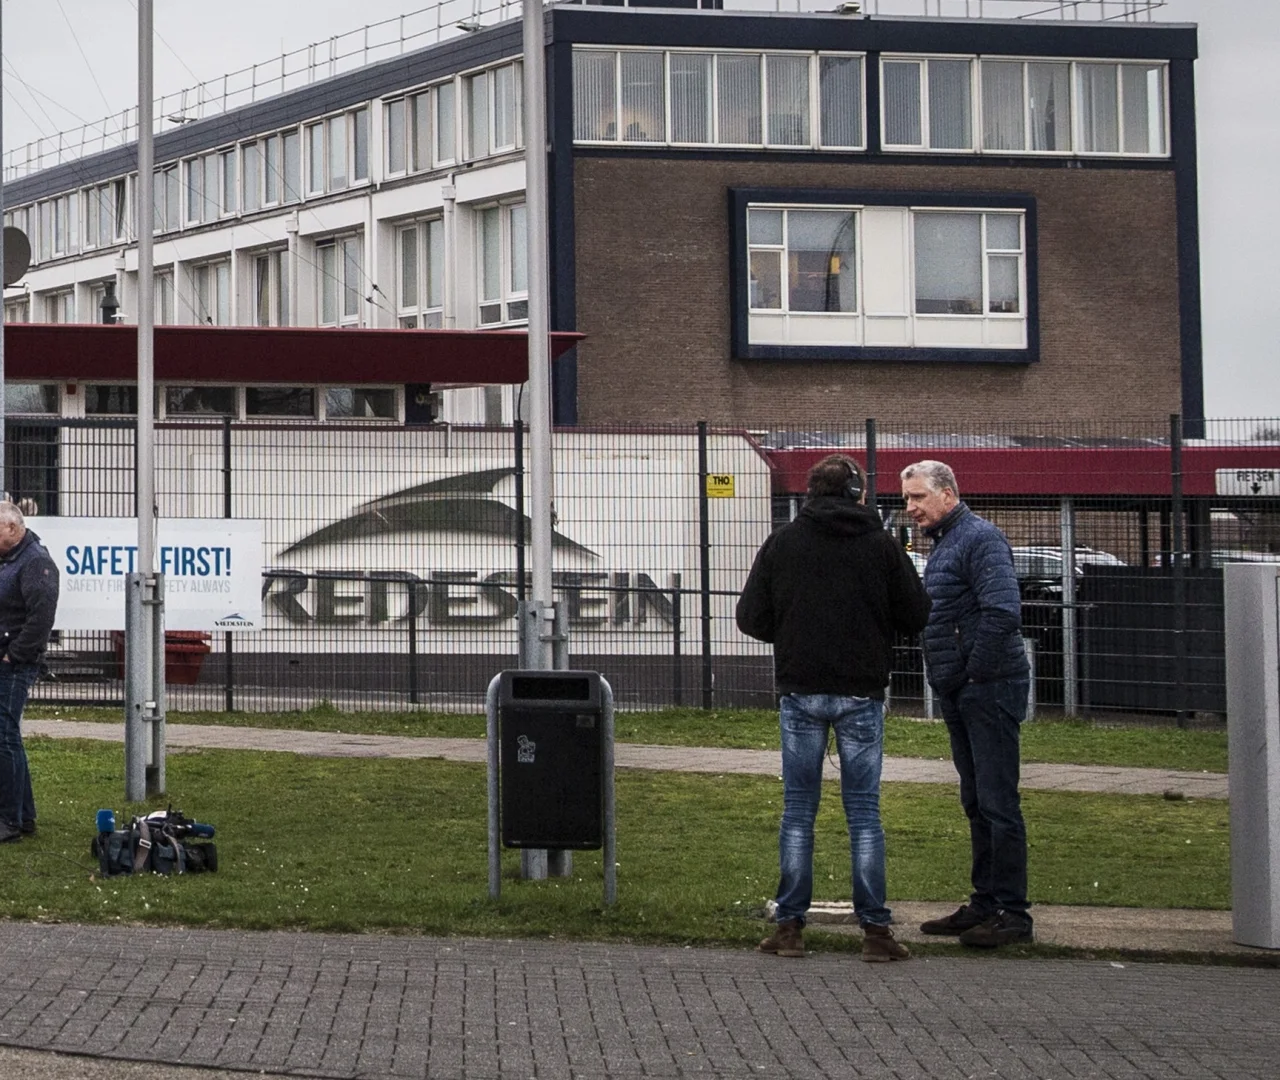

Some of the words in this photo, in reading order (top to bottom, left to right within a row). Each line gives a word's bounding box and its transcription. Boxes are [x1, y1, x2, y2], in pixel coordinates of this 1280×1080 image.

[712, 475, 730, 486] THO
[1236, 470, 1275, 482] FIETSEN
[66, 545, 139, 576] SAFET
[160, 546, 232, 577] FIRST!
[66, 578, 105, 593] SAFETY
[107, 578, 127, 593] FIRS
[165, 579, 190, 594] FETY
[190, 579, 231, 594] ALWAYS
[261, 569, 682, 623] REDESEIN
